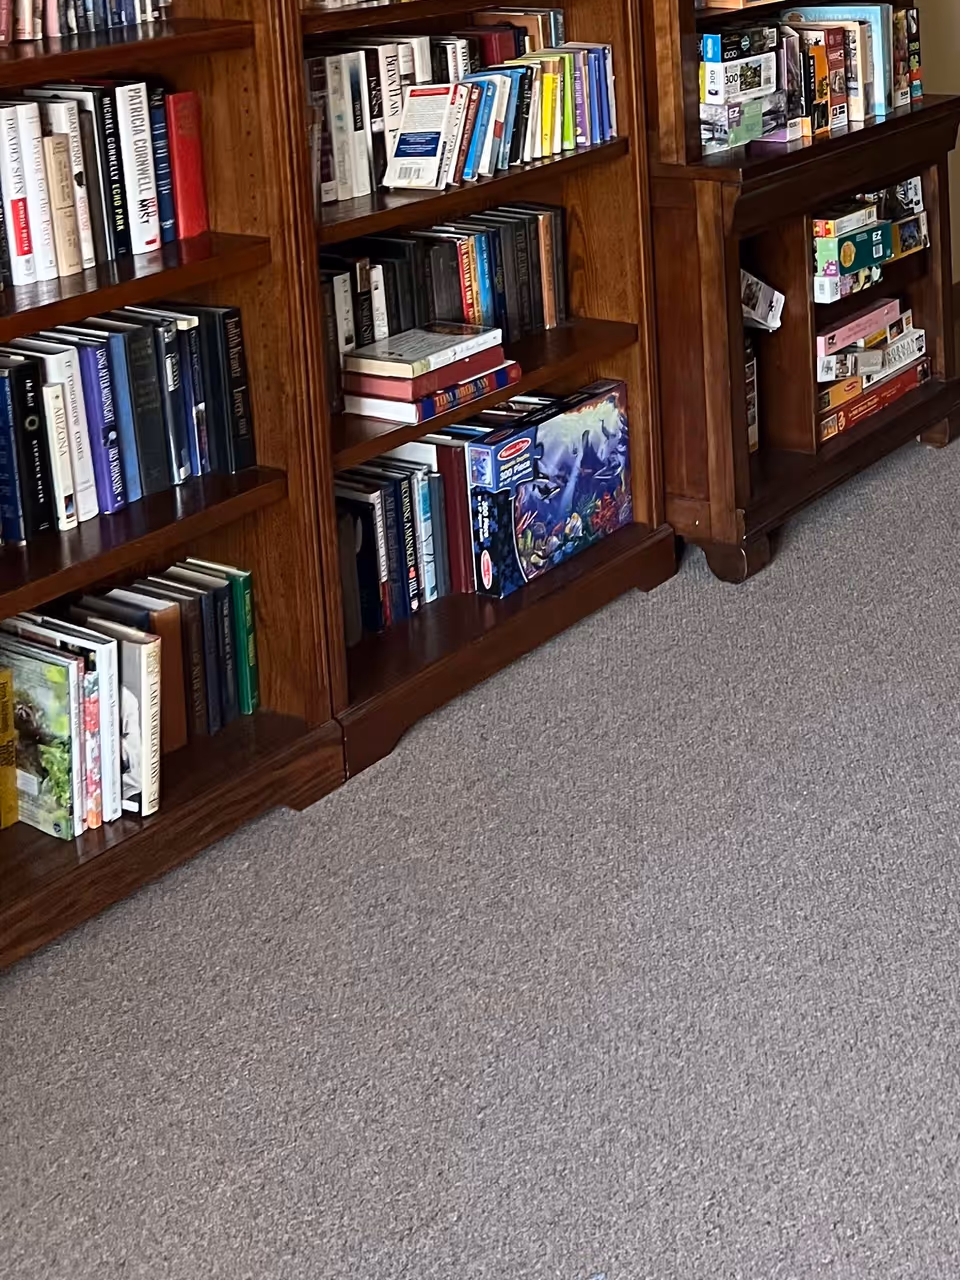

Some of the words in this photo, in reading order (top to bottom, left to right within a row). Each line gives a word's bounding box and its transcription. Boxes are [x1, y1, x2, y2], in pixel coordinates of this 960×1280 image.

[385, 54, 399, 85] BELVA
[725, 73, 739, 84] 300
[369, 77, 379, 115] JACKSON
[388, 88, 401, 117] PLAIN
[66, 106, 79, 134] BRIAN
[102, 97, 114, 134] MICHAEL
[127, 87, 146, 136] PATRICIA
[729, 108, 740, 118] EZ
[6, 118, 21, 164] DEADLY
[32, 136, 43, 174] Paying
[70, 136, 83, 167] KEENAN
[107, 137, 119, 180] CONNELLY
[134, 139, 152, 195] CORNWELL
[10, 167, 24, 195] SPIN
[38, 178, 47, 193] for
[112, 184, 121, 206] ECHO
[40, 197, 50, 216] the
[115, 209, 124, 231] PARK
[137, 199, 150, 225] MIST
[42, 219, 52, 247] Party
[872, 230, 882, 241] EZ
[225, 317, 241, 347] Judith
[95, 348, 107, 368] LONG
[887, 338, 915, 357] NORMAN
[229, 348, 243, 378] Krantz
[97, 369, 110, 389] AFTER
[435, 392, 454, 407] TOM
[455, 377, 489, 398] BROKAW
[100, 389, 115, 423] MIDNIGHT
[232, 386, 246, 417] Lovers
[53, 407, 68, 457] ARIZONA
[67, 375, 80, 425] TOMORROW
[74, 431, 84, 461] COMES
[31, 440, 41, 479] STEPHENIE
[108, 448, 119, 460] IRIS
[109, 461, 123, 494] JOHANSEN
[500, 468, 512, 480] 300
[514, 461, 530, 473] Piece
[35, 481, 45, 504] MEYER
[385, 496, 394, 508] All
[400, 480, 411, 522] BECOMING
[387, 512, 395, 525] the
[404, 528, 416, 568] MANAGER
[408, 578, 418, 597] HILL
[148, 681, 160, 708] LAKE
[149, 713, 160, 759] WOBEGON
[150, 760, 160, 785] DAYS
